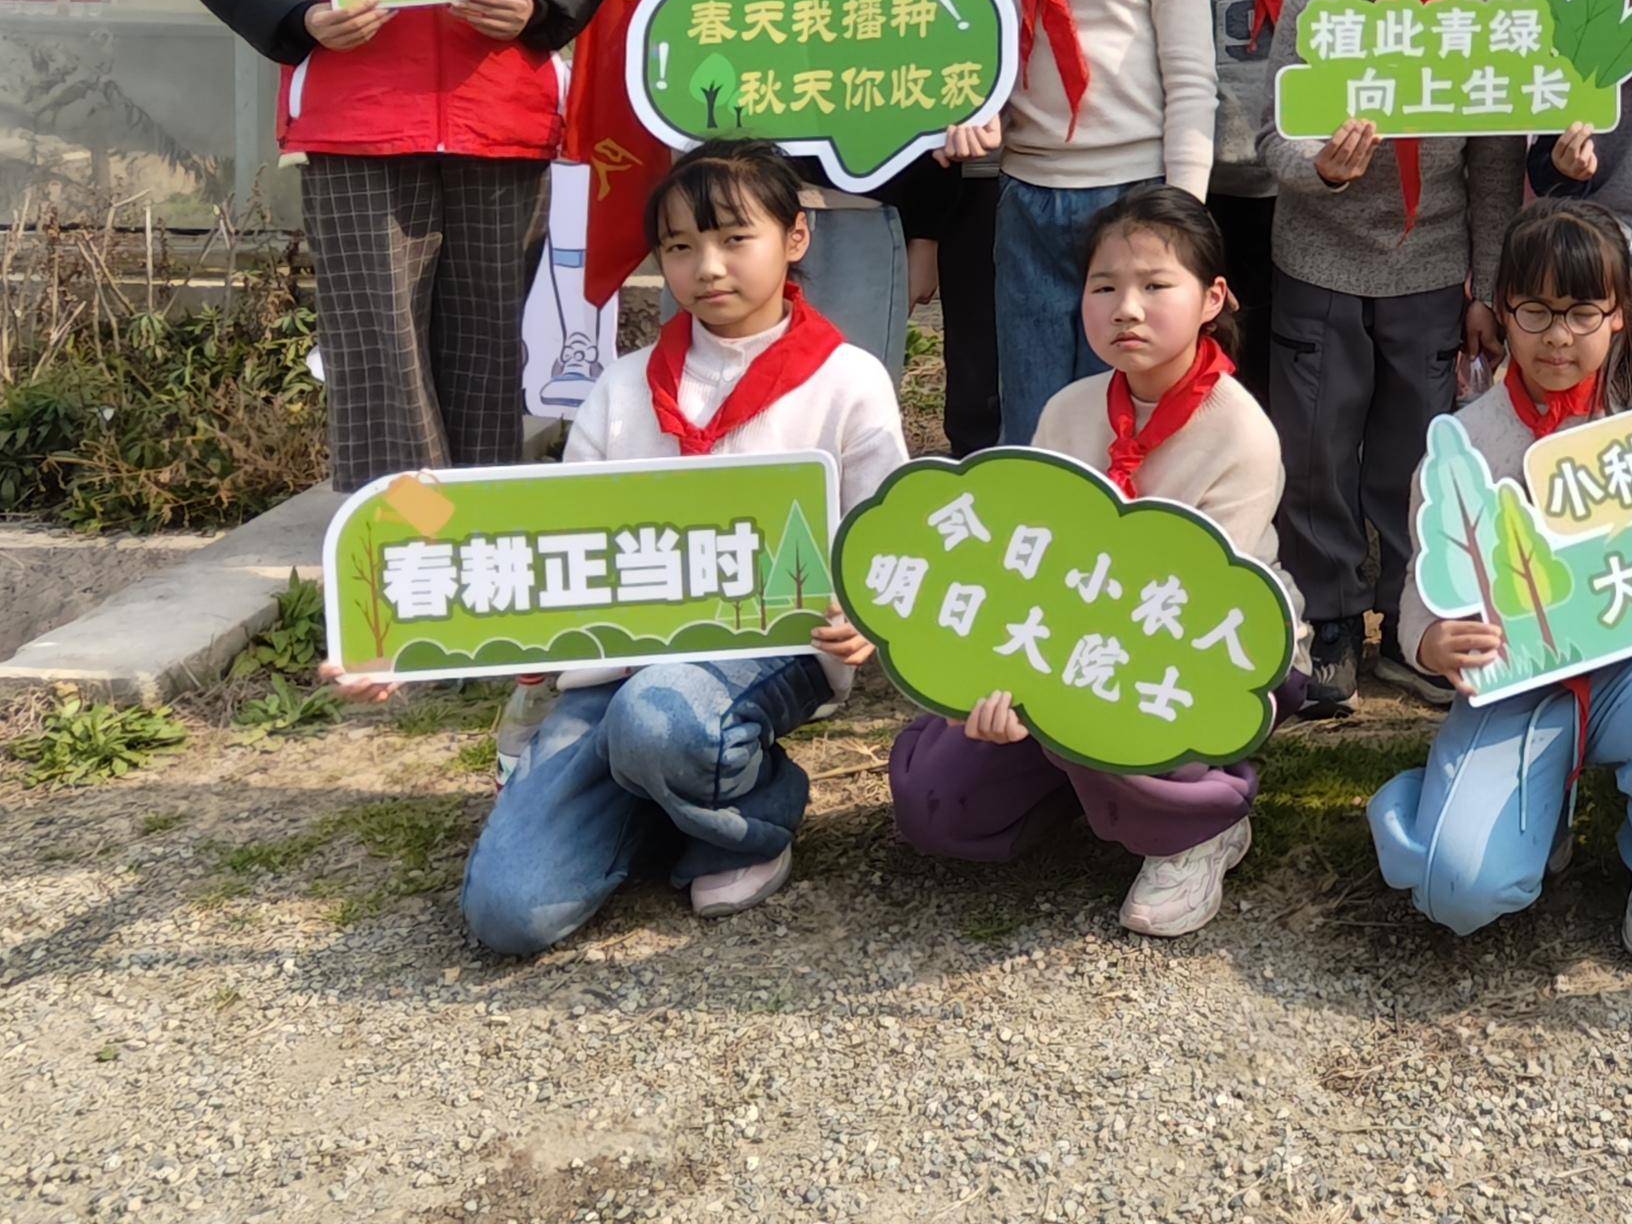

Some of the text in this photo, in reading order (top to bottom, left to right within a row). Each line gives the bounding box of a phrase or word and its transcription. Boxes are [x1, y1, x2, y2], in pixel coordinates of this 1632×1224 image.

[1310, 7, 1543, 60] 植此青绿
[737, 61, 986, 116] 秋天你收获
[1345, 64, 1572, 117] 向上生长
[380, 519, 764, 621] 春耕正当时
[926, 491, 1257, 673] 今日小农人
[864, 553, 1196, 723] 明日大院士
